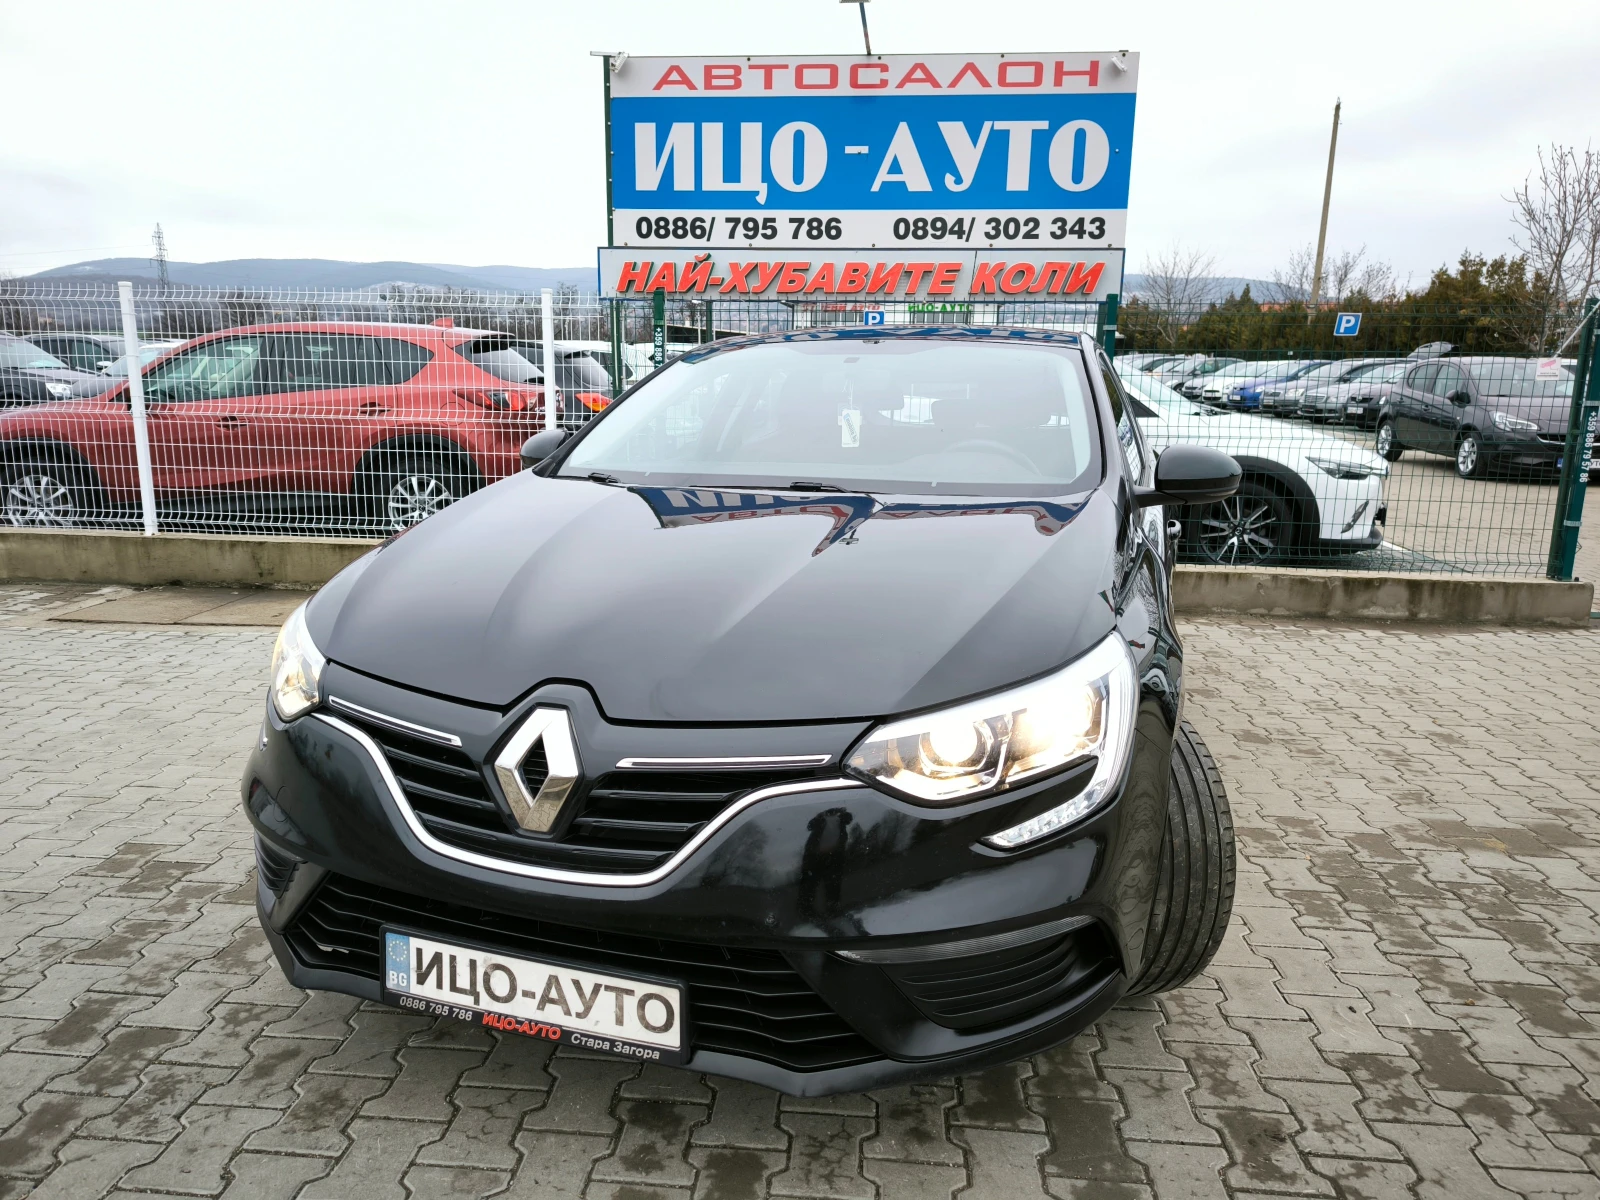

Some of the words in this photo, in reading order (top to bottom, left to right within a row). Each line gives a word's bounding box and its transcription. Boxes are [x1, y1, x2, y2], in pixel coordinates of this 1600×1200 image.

[652, 60, 1100, 91] АВТОСАЛОН
[635, 217, 716, 242] 0886/
[724, 217, 778, 241] 795
[789, 217, 842, 241] 786
[892, 217, 976, 242] 0894/
[983, 217, 1040, 240] 302
[1049, 217, 1106, 240] 343
[616, 253, 963, 296] НАЙ-ХУБАВИТЕ
[970, 261, 1106, 295] КОЛИ
[1339, 315, 1356, 333] P
[1587, 411, 1597, 431] +359
[1585, 432, 1595, 448] 886
[1581, 460, 1591, 471] 57
[1583, 449, 1592, 459] 79
[1579, 472, 1589, 483] 86
[389, 970, 407, 987] BG
[415, 947, 675, 1034] ИЦО-АУТО
[400, 996, 426, 1011] 0886
[429, 1003, 449, 1016] 795
[452, 1008, 473, 1021] 786
[481, 1012, 562, 1041] ИЦО-АУТО
[570, 1033, 610, 1050] Стара
[613, 1041, 661, 1060] Загора
